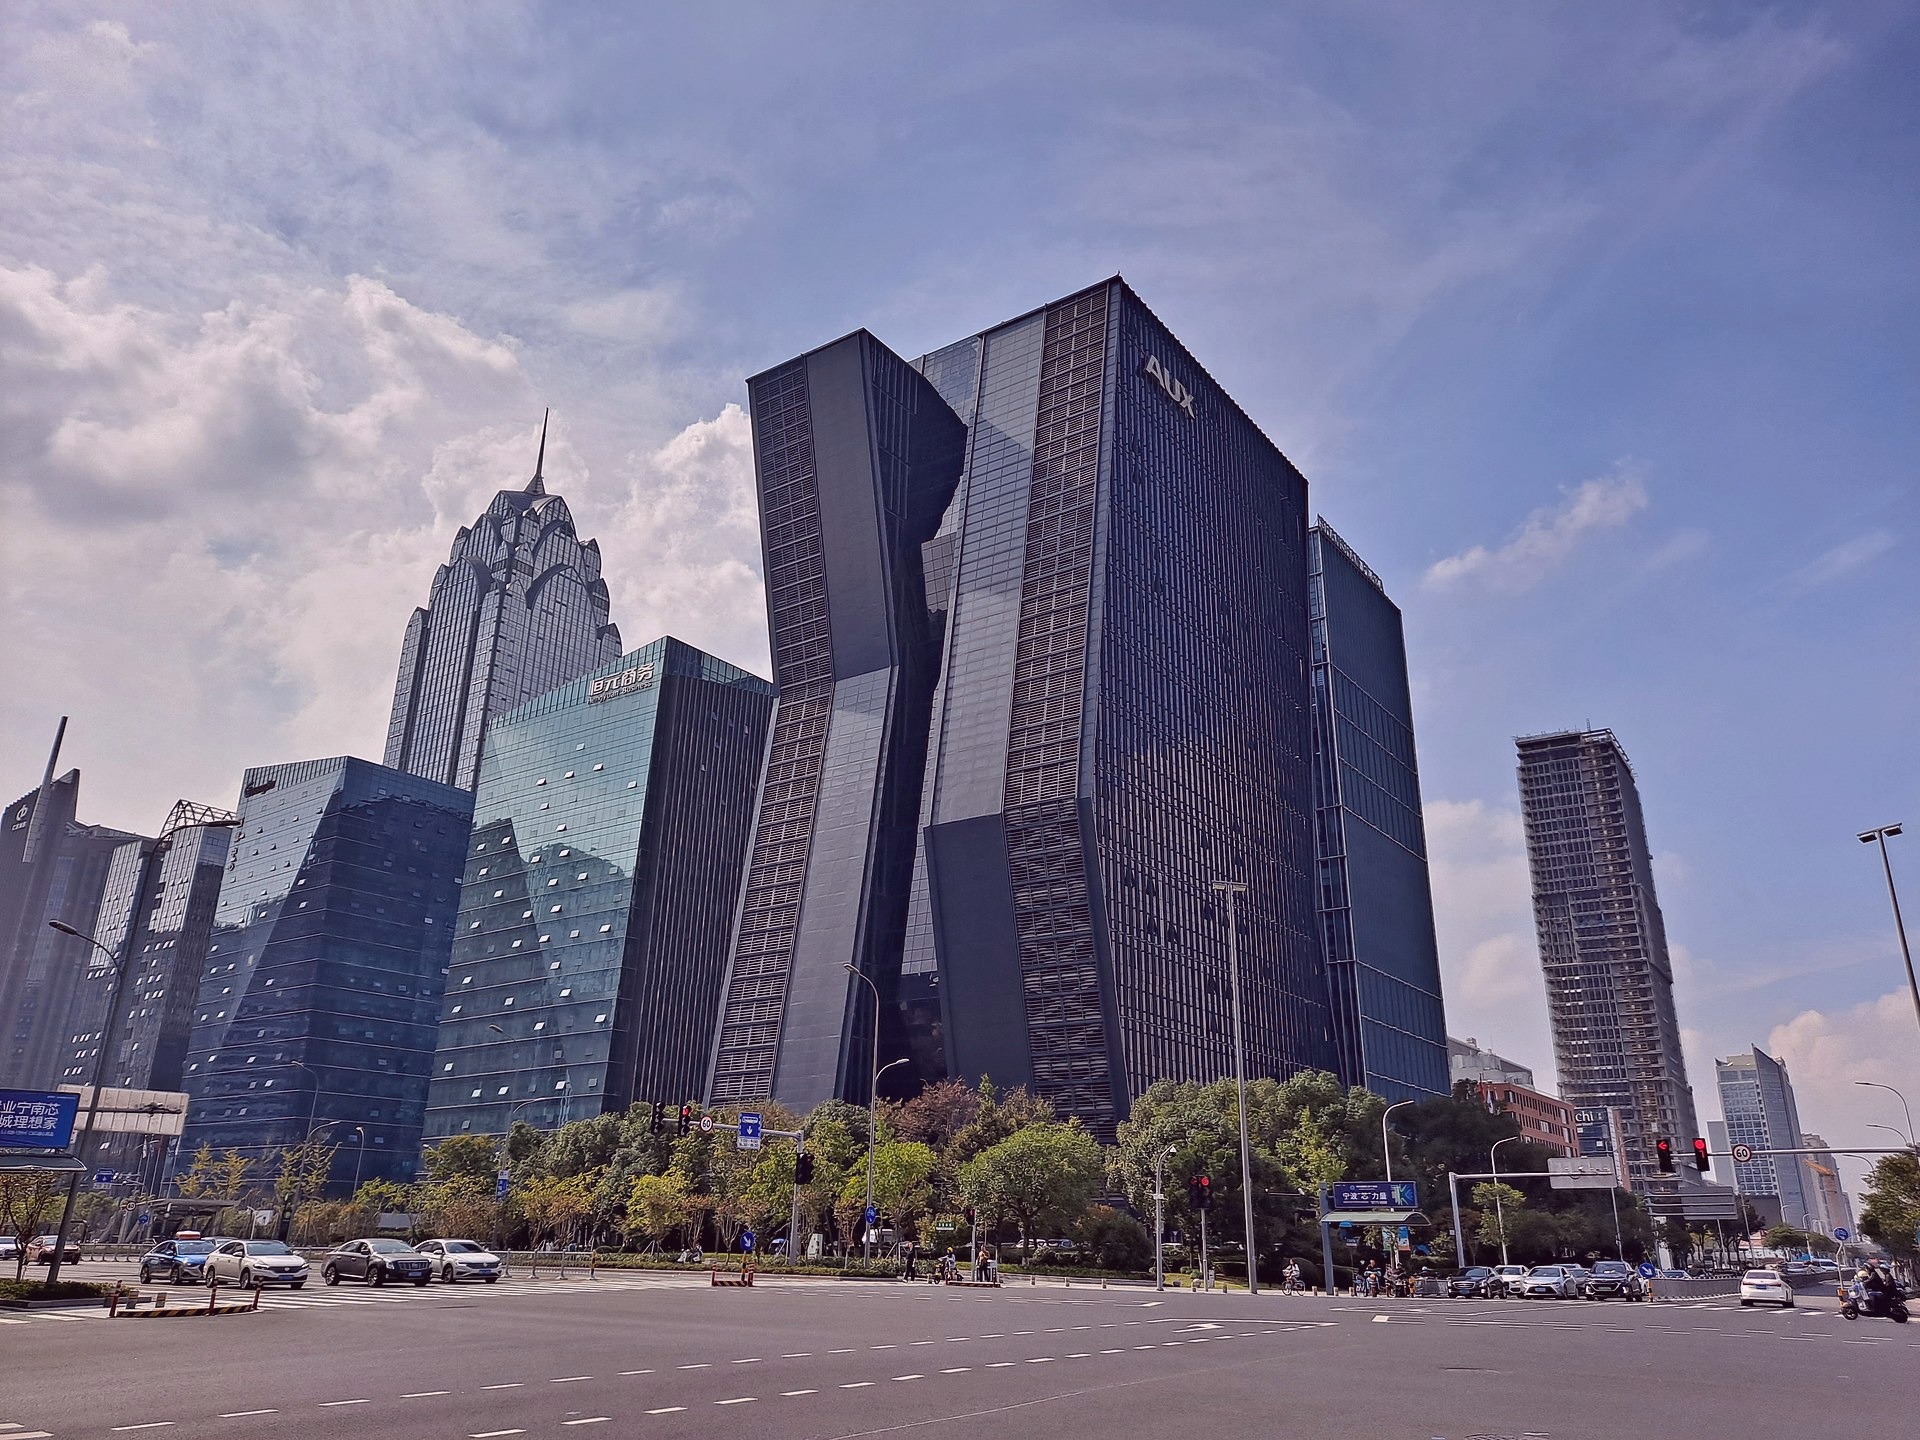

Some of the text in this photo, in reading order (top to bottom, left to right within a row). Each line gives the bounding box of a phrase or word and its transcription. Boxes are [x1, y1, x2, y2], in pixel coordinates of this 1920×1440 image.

[1145, 354, 1195, 419] AUX
[0, 1100, 61, 1116] 业宁南芯
[702, 1119, 711, 1128] 60
[1736, 1148, 1748, 1158] 60
